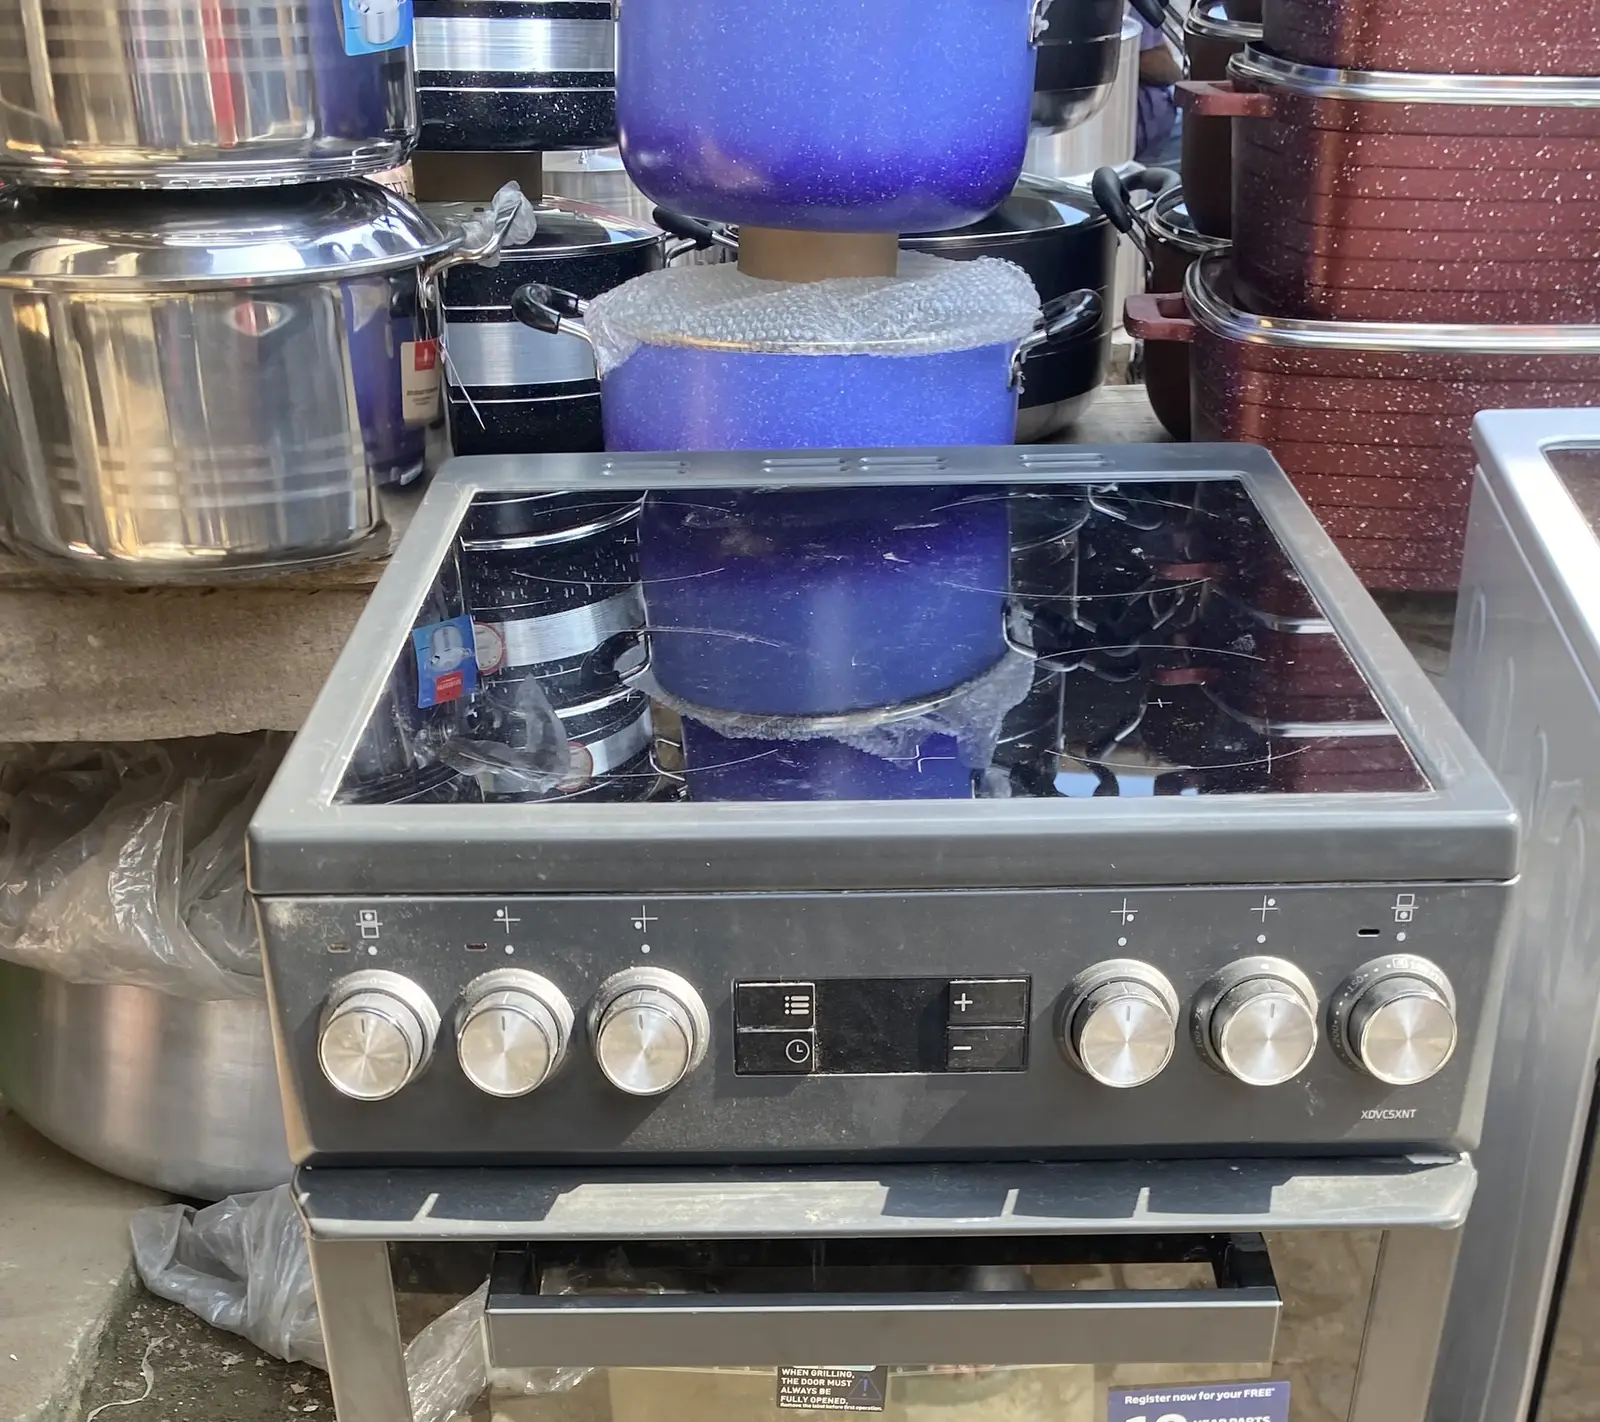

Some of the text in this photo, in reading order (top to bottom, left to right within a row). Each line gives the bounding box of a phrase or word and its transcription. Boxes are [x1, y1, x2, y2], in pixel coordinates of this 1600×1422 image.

[781, 1368, 855, 1379] WHEN GRILLING,
[781, 1377, 853, 1387] THE DOOR MUST
[780, 1387, 817, 1395] ALWAYS
[780, 1395, 849, 1405] FULLY OPENED.
[1124, 1394, 1171, 1406] Register
[1172, 1393, 1196, 1402] now
[1198, 1391, 1215, 1401] for
[1216, 1390, 1243, 1402] your
